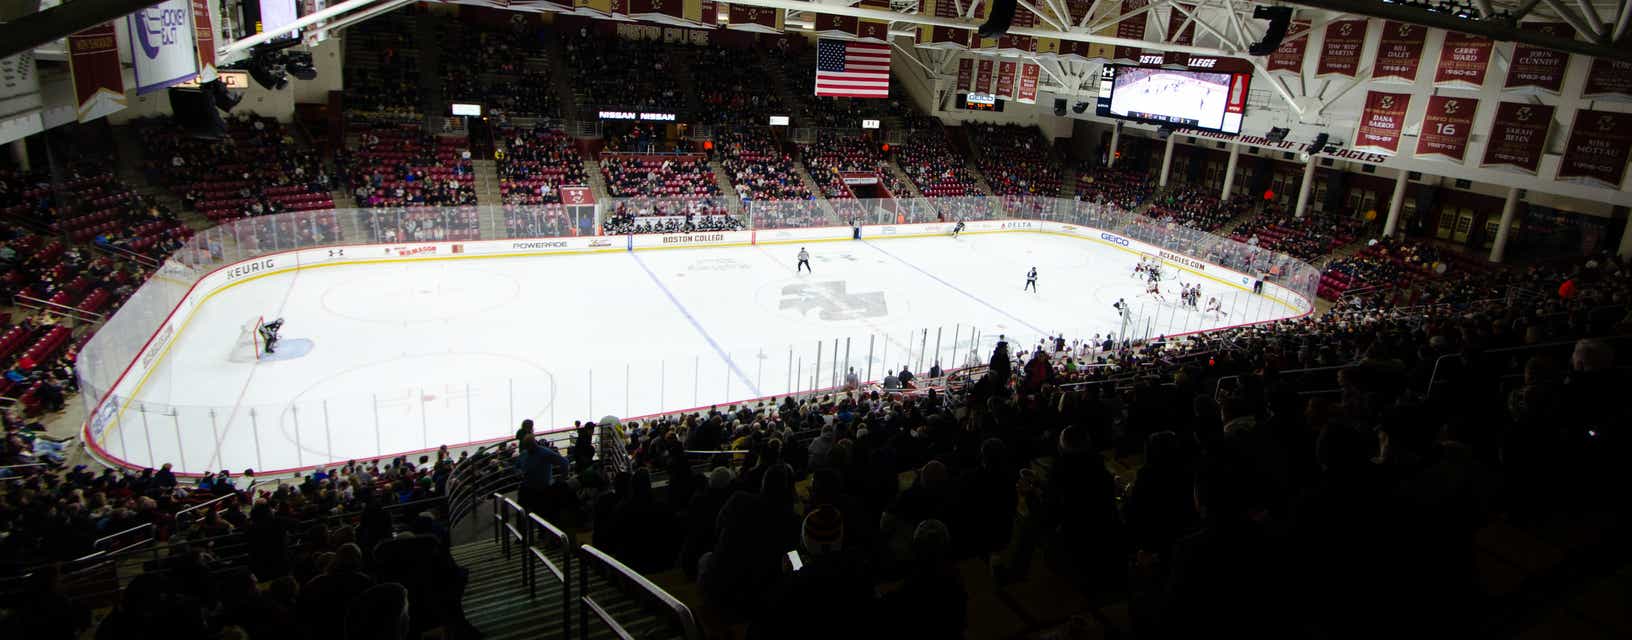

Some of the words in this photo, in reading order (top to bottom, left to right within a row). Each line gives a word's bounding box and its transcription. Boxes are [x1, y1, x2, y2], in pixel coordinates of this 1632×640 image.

[161, 9, 186, 27] HOCKEY
[1453, 54, 1478, 62] WARD
[599, 111, 635, 120] NISSAN
[640, 113, 675, 122] NISSAN
[1373, 114, 1393, 122] DANA
[1369, 121, 1395, 129] BARROS
[1436, 123, 1456, 135] 16
[663, 235, 693, 243] BOSTON
[695, 233, 724, 242] COLLEGE
[1101, 233, 1129, 247] GEICO
[512, 241, 569, 249] POWERADE
[226, 259, 275, 280] KEURIG
